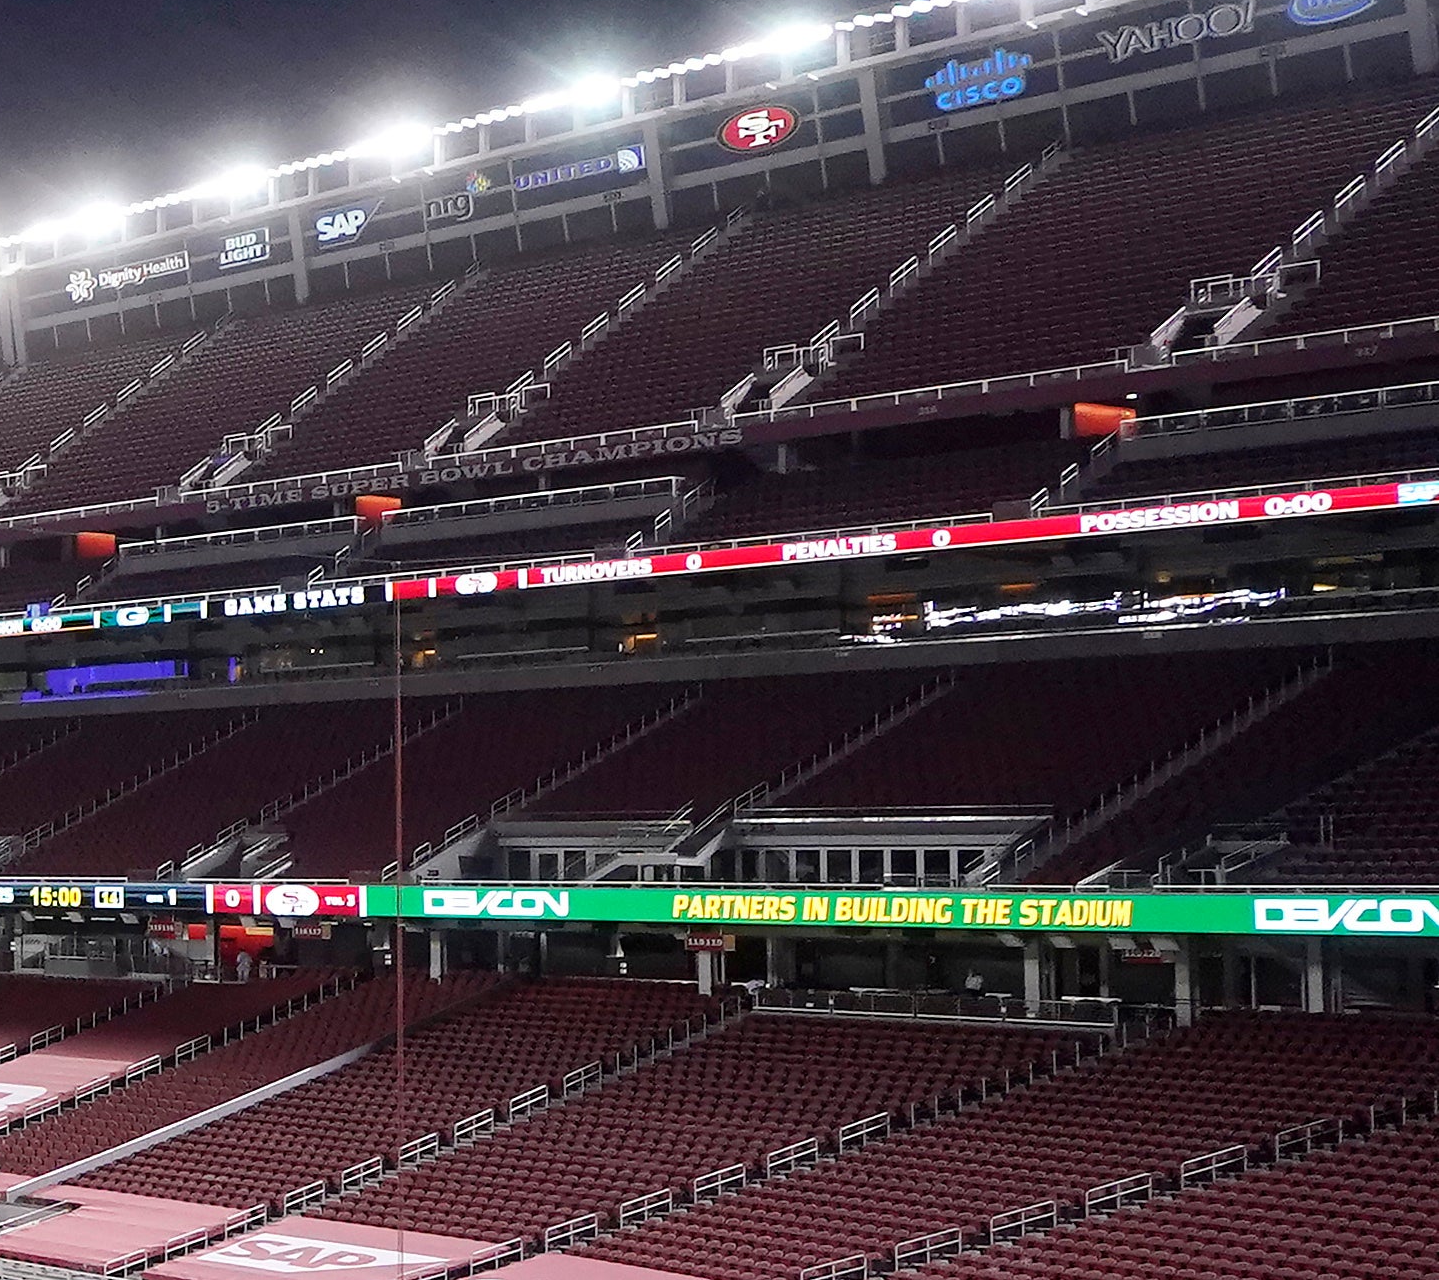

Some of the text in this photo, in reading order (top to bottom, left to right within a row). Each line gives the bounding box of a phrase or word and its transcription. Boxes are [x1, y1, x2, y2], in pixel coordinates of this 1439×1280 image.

[934, 73, 1026, 111] CISCO
[514, 157, 614, 191] UNITED
[223, 232, 258, 250] BUD
[315, 209, 367, 242] SAP
[219, 244, 264, 267] LIGHT
[97, 255, 186, 290] Dignity Health
[206, 427, 744, 514] 5-TIME SUPER BOWL CHAMPIONS
[1079, 492, 1333, 534] POSSESSION 0:00
[781, 528, 951, 562] PENALTIES 0
[540, 552, 703, 585] TURNOVERS 0
[225, 586, 365, 617] GAME STATS
[29, 885, 82, 908] 15:00
[100, 888, 120, 907] 14
[167, 888, 177, 907] 1
[225, 888, 241, 908] 0
[423, 889, 570, 918] DEVCON
[672, 894, 1133, 928] PARTNERS IN BUILDING THE STADIUM
[222, 1240, 381, 1270] SAP
